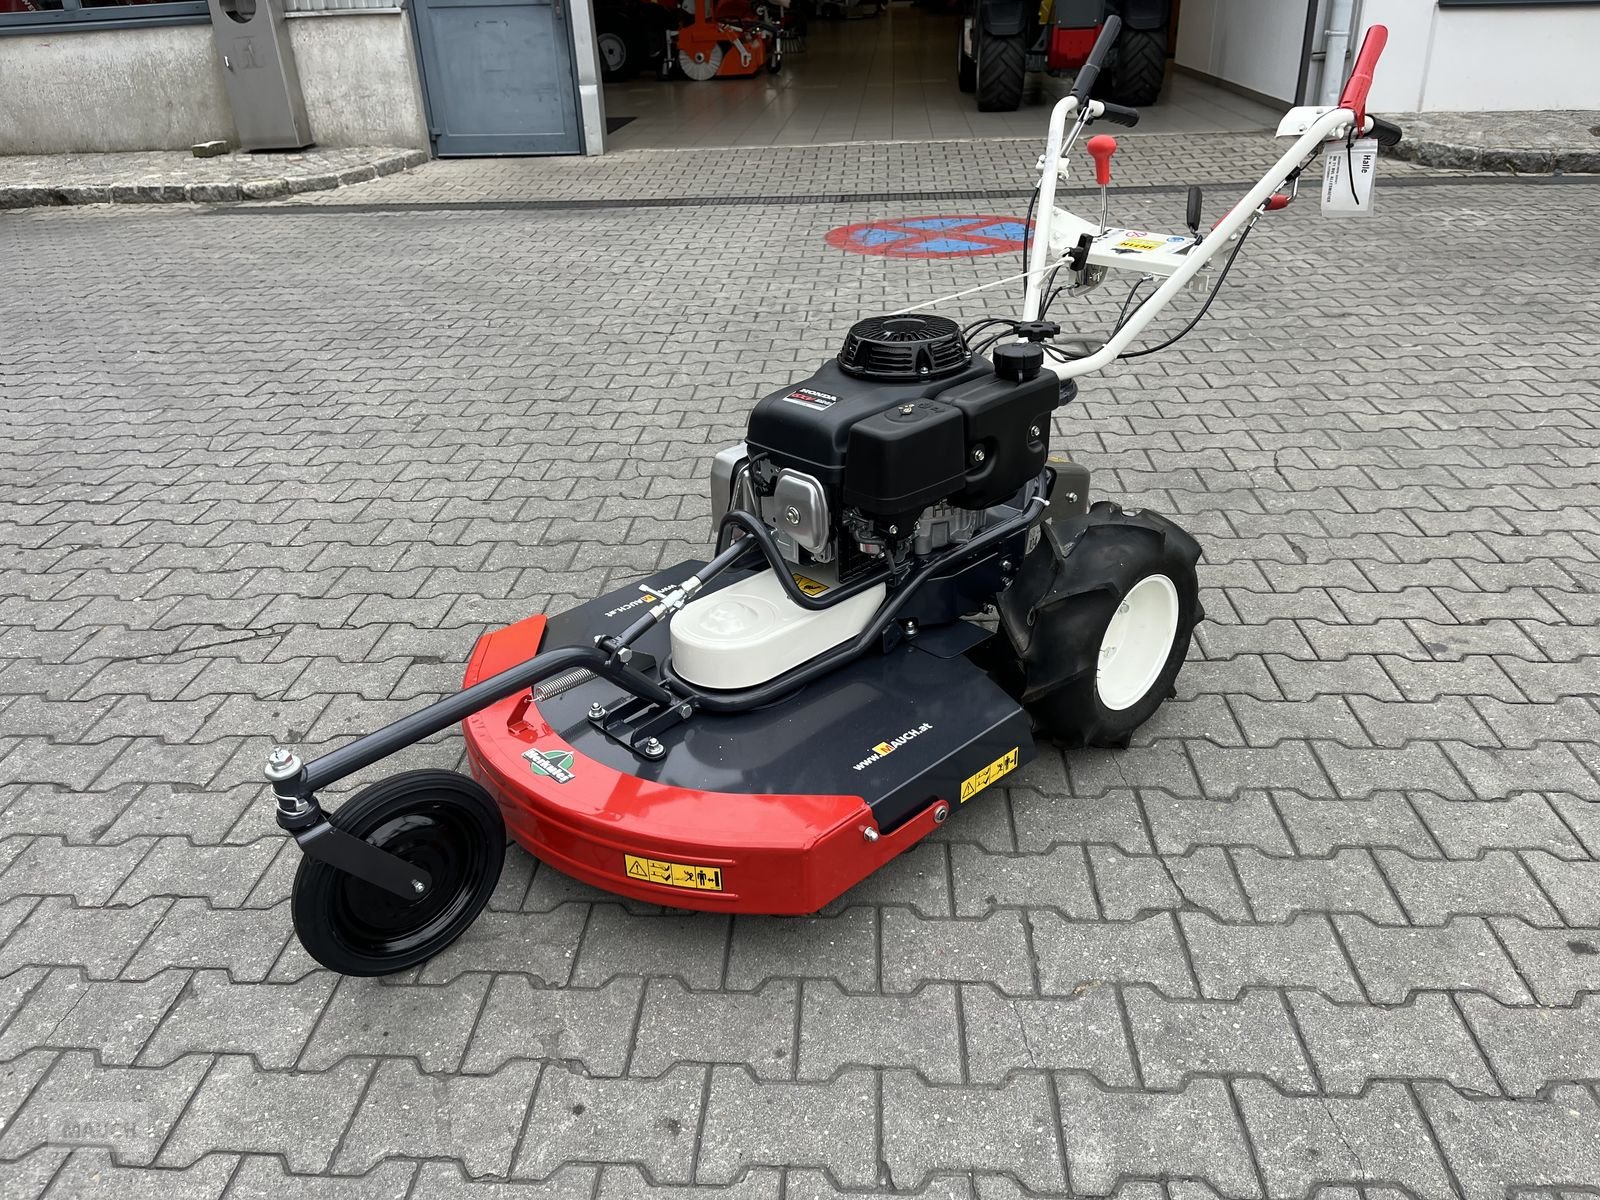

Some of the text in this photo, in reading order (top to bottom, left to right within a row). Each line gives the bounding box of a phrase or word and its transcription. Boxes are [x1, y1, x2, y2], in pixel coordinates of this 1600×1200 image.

[1361, 154, 1371, 174] Halle
[799, 388, 837, 402] HONDA
[853, 722, 933, 771] www.MAUCH.at
[523, 749, 570, 783] Herkules
